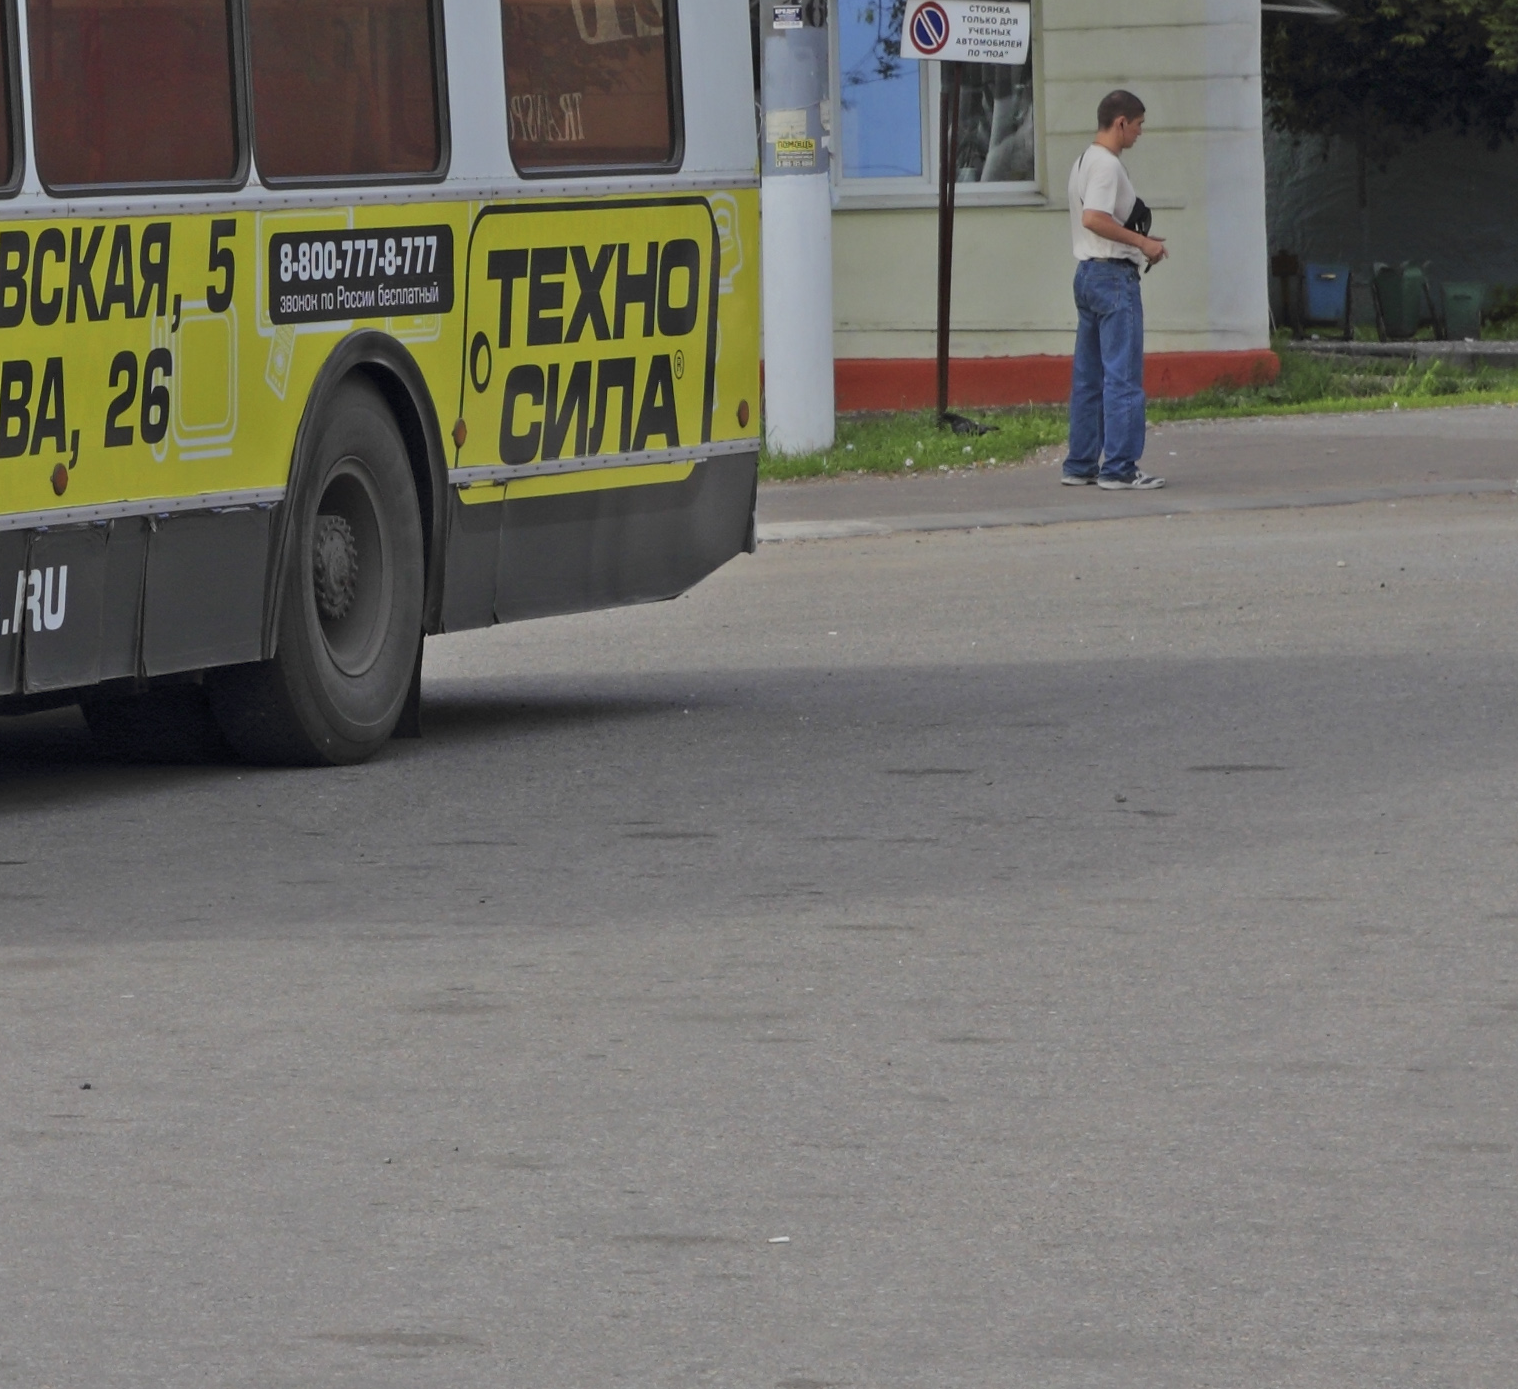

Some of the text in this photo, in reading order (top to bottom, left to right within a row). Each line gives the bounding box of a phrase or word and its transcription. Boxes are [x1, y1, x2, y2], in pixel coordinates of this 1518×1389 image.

[961, 16, 1019, 26] ТОЛЬКО ДЛЯ
[969, 5, 1011, 15] СТОЯНКА
[955, 38, 1023, 49] АВТОМОБИЛЕЙ
[968, 27, 1012, 36] УЧЕБНЫХ
[967, 49, 980, 58] ПО
[206, 218, 237, 313] 5
[280, 235, 438, 283] 8-800-777-8-777
[279, 281, 439, 314] звонок по России бесплатный
[487, 238, 700, 350] ТЕХНО
[104, 347, 173, 448] 26
[498, 353, 681, 467] СИЛА
